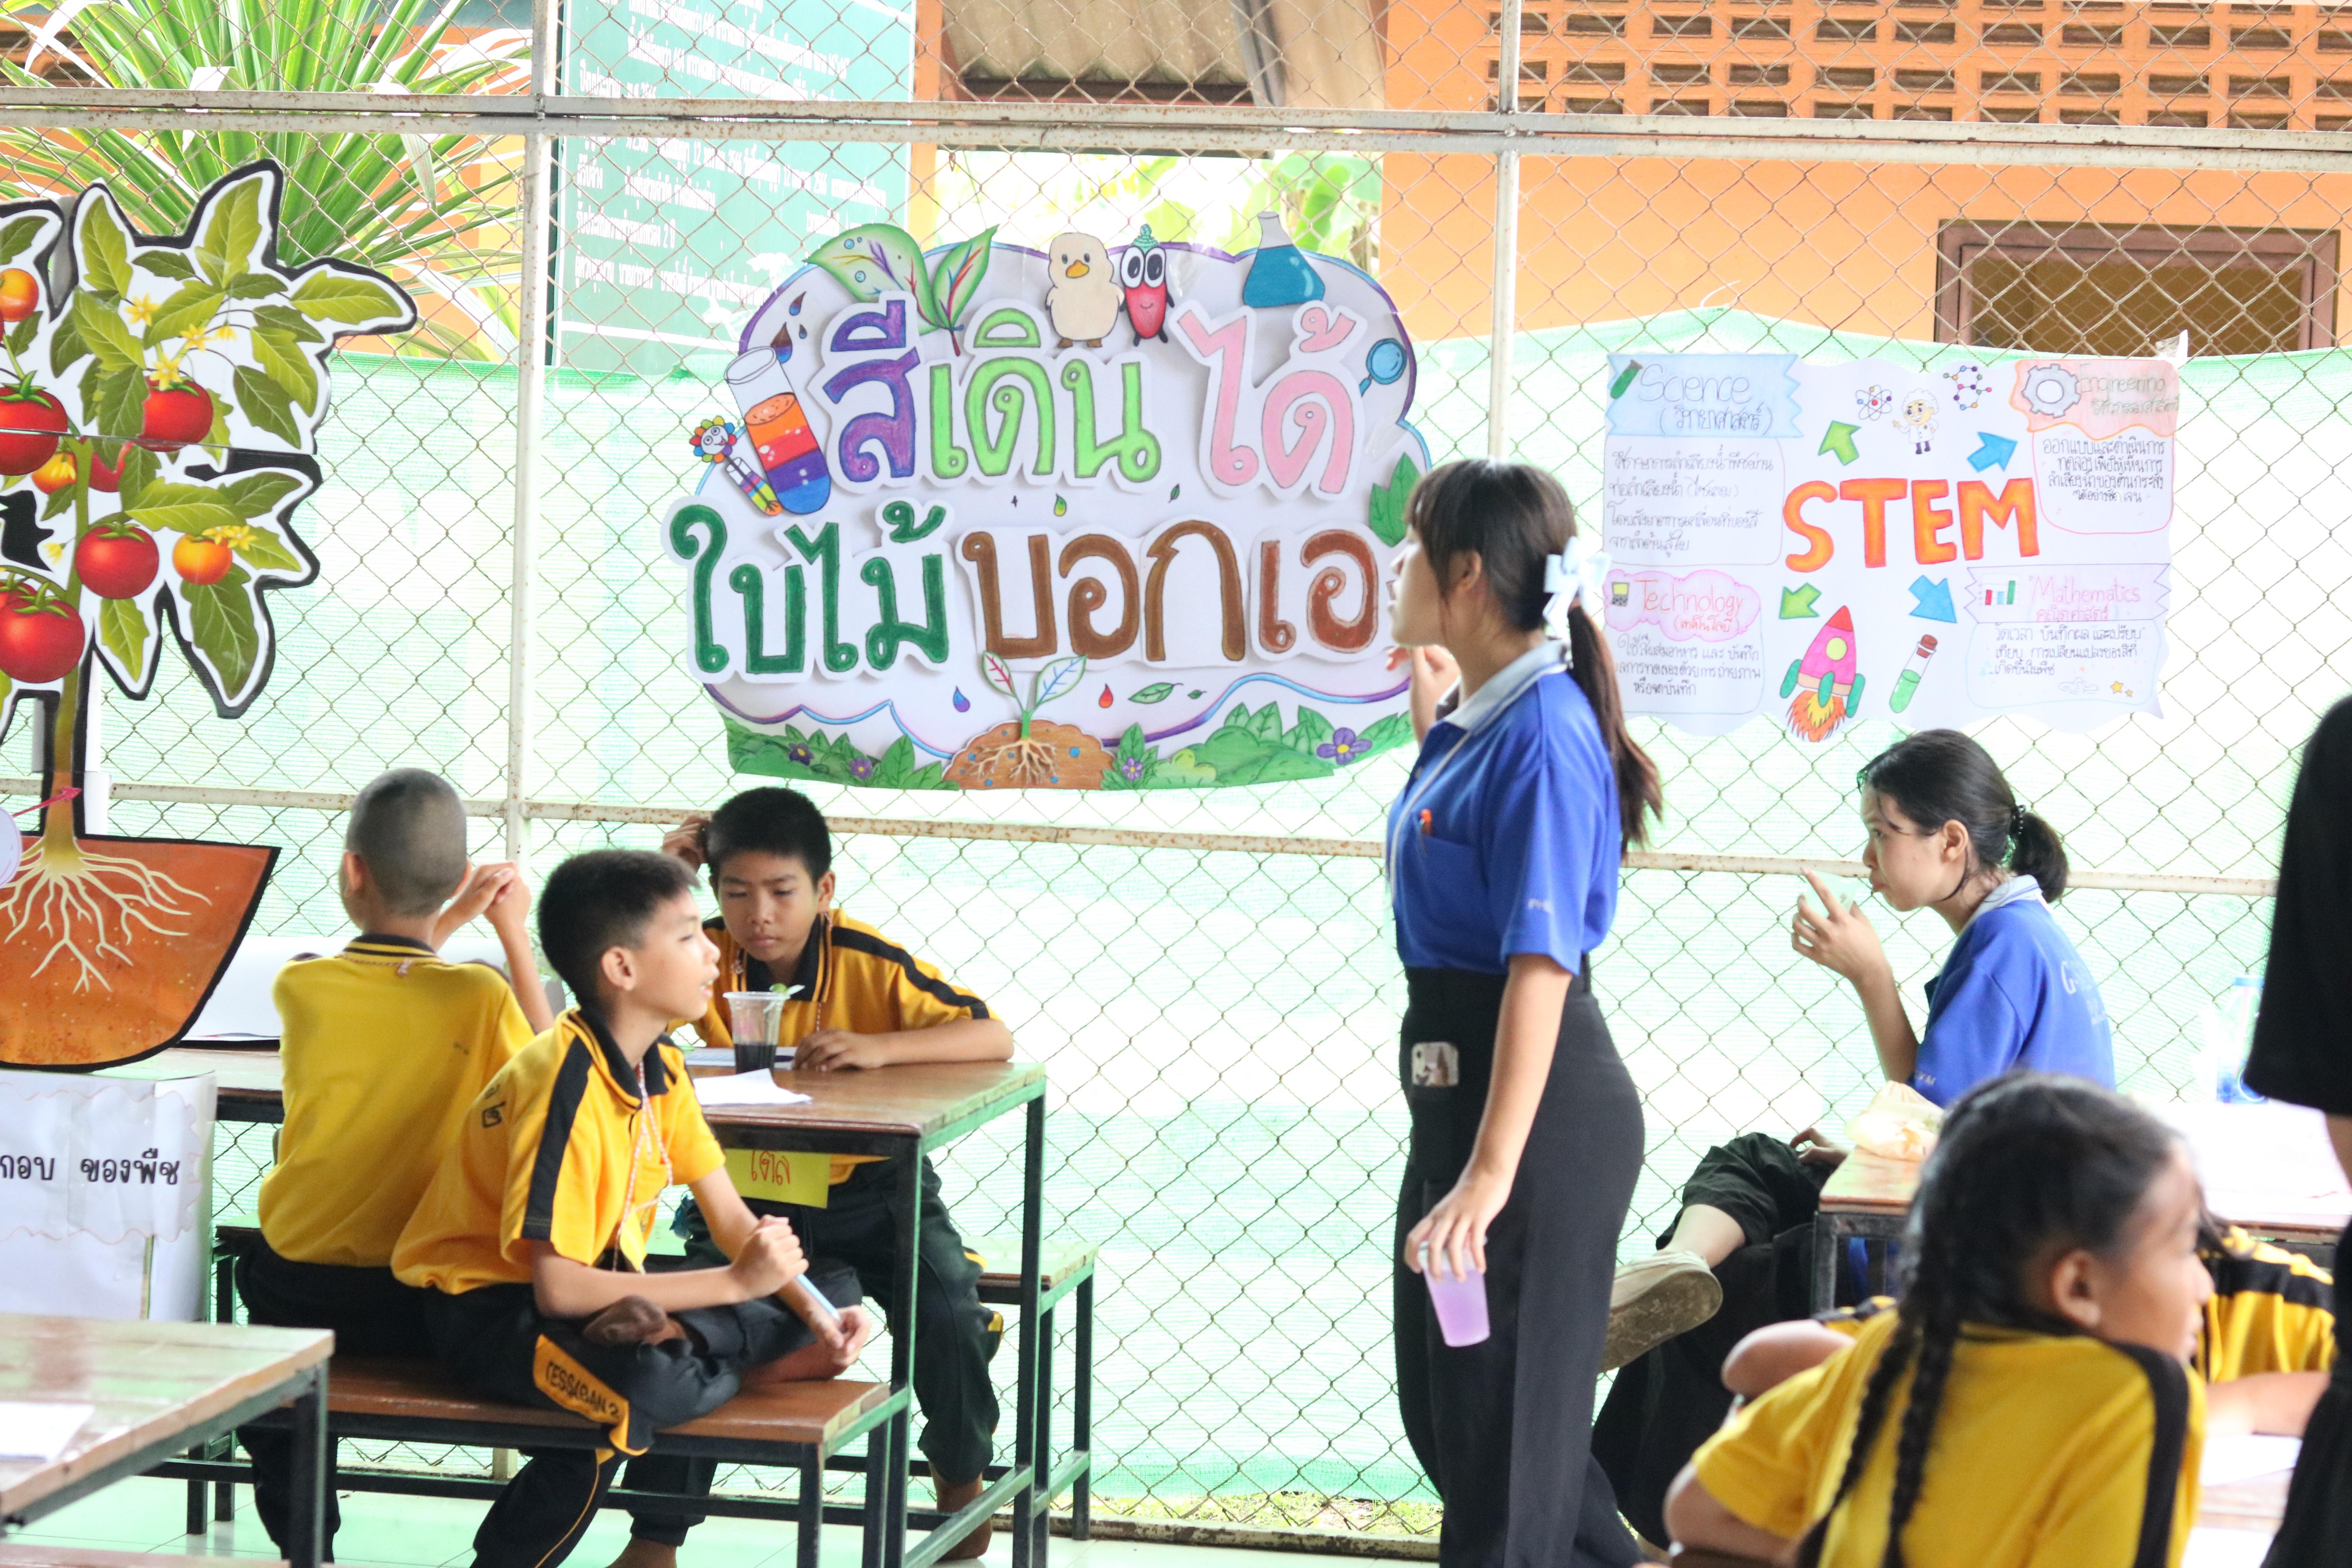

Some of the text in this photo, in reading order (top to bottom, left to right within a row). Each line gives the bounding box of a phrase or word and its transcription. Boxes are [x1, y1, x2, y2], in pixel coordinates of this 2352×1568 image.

[1638, 363, 1752, 404] Science
[2080, 362, 2166, 402] Engineering
[1783, 477, 2039, 573] STEM
[1633, 578, 1743, 617] Technology
[2031, 576, 2141, 604] Mathematics
[80, 1148, 180, 1185] ของพืช
